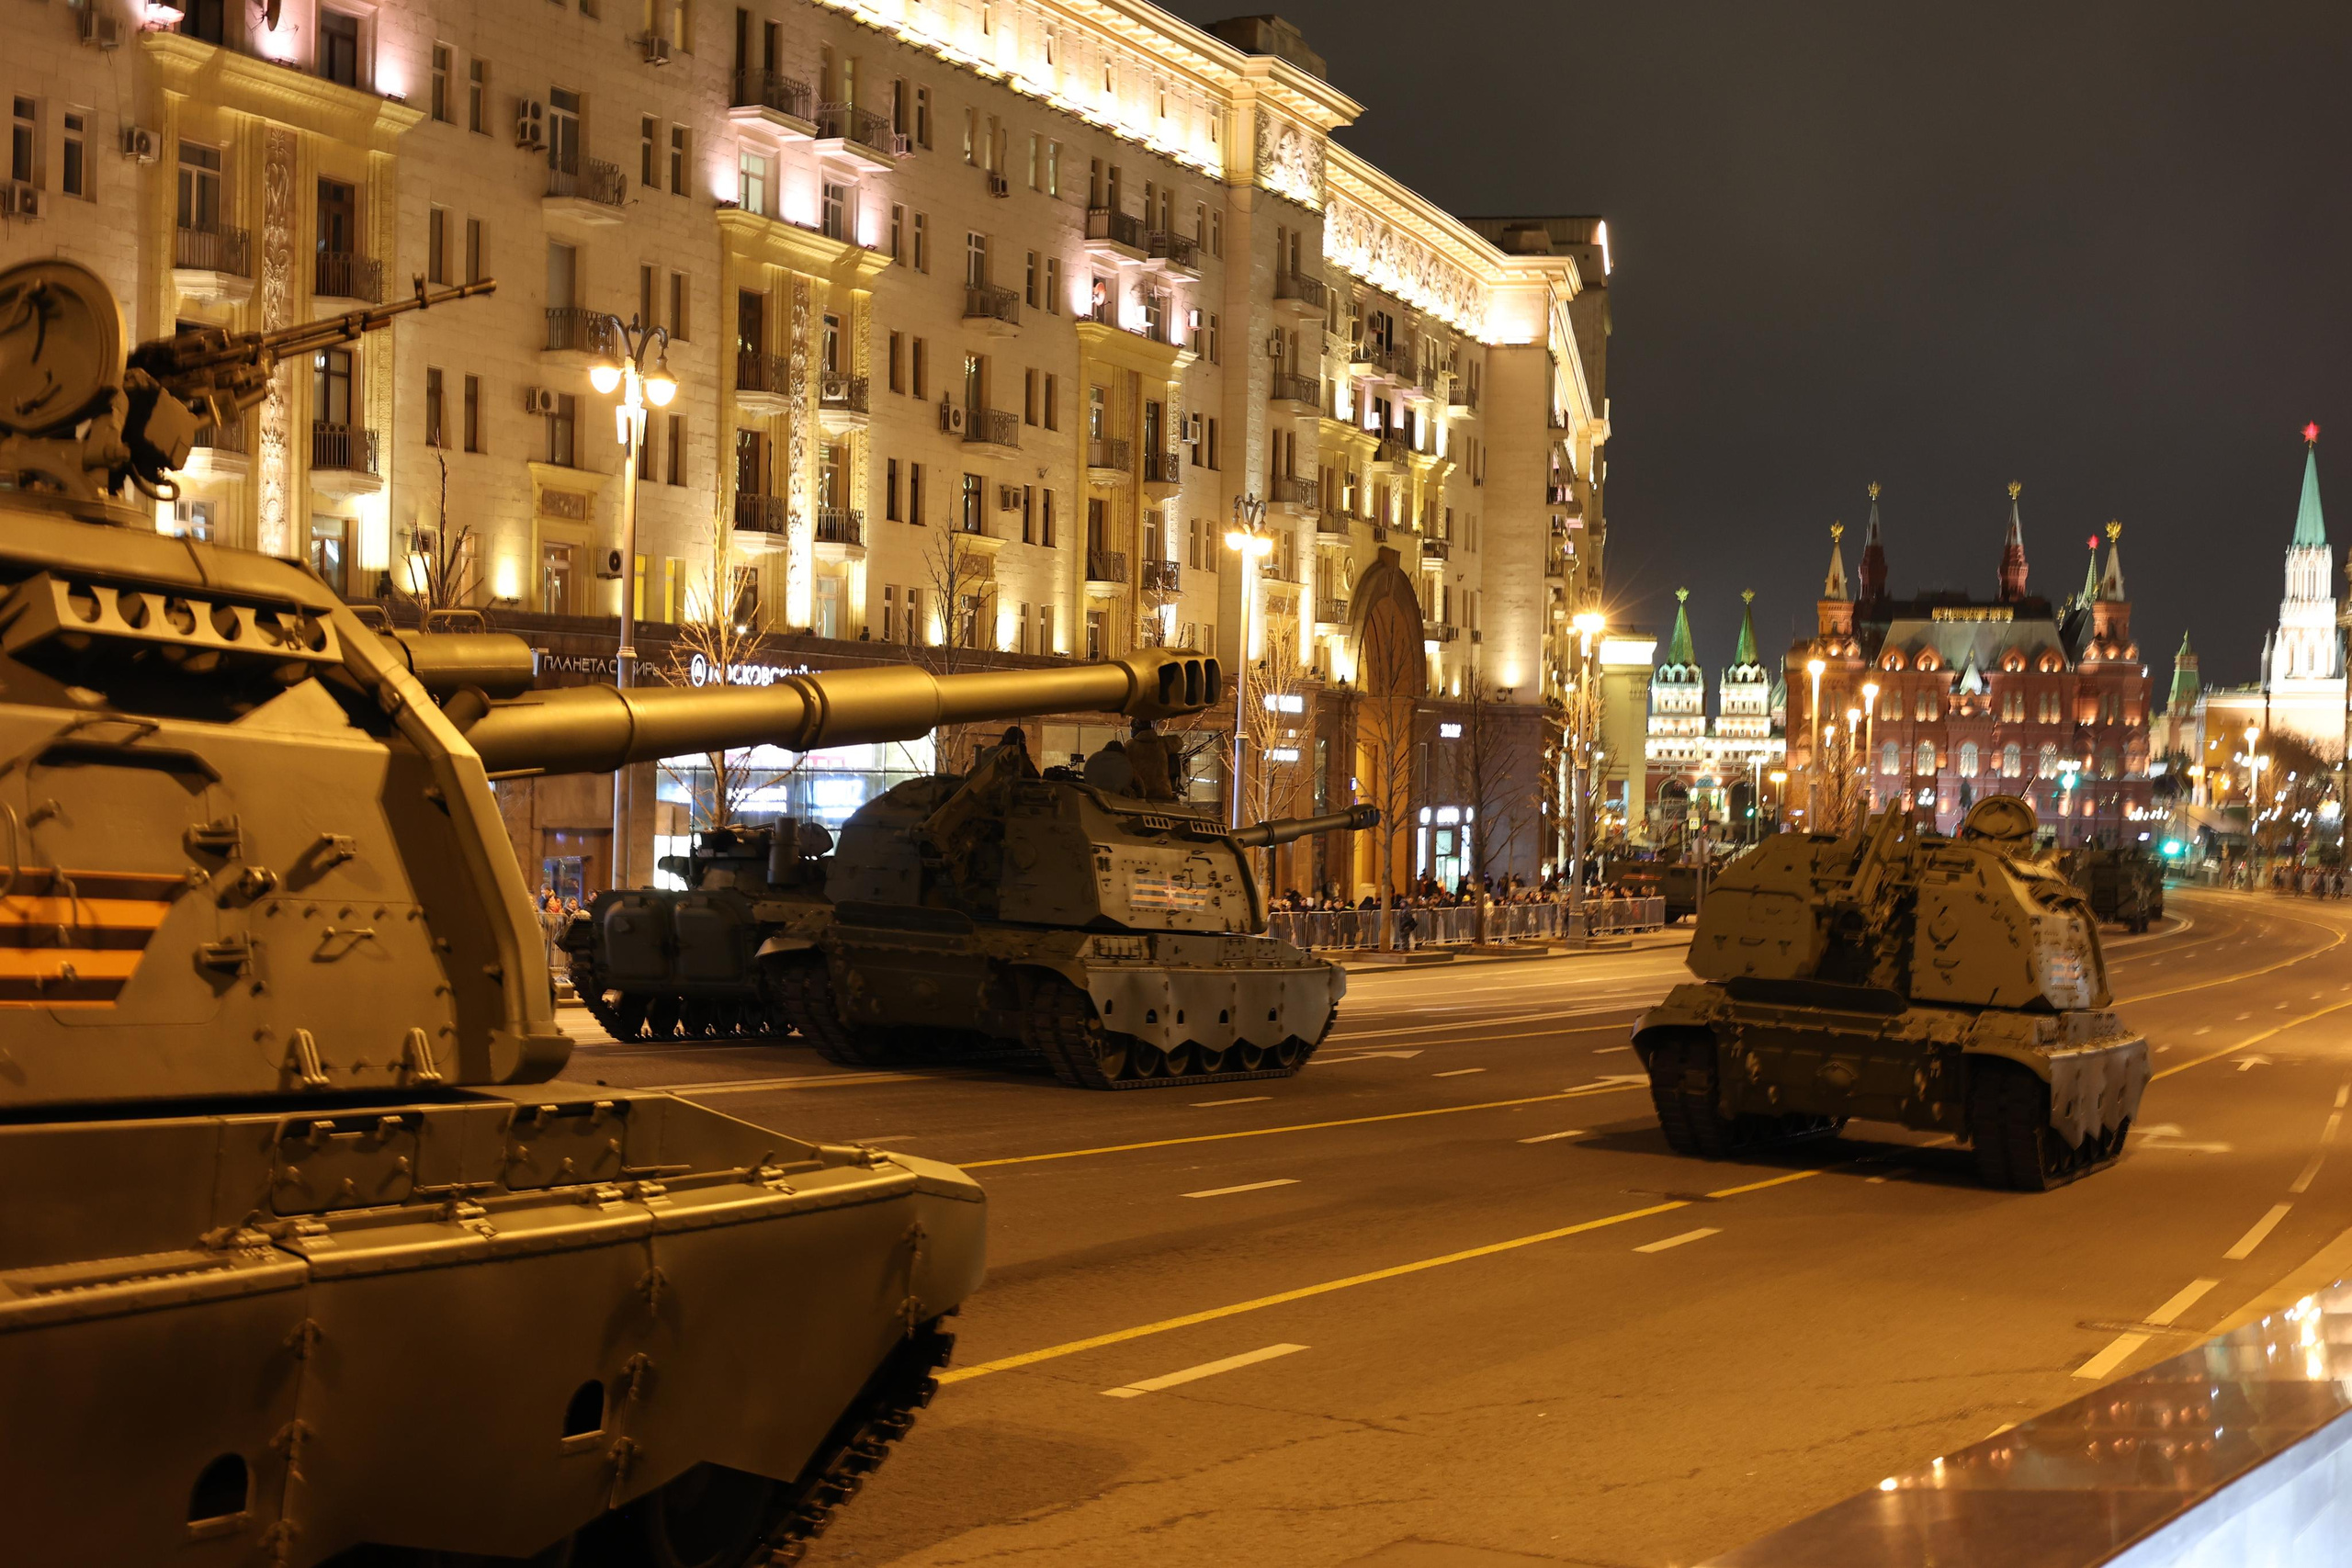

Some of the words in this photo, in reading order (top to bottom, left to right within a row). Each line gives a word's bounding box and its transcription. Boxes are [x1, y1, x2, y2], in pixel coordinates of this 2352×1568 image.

[543, 655, 607, 673] ПЛАНЕТА
[608, 660, 660, 677] СИРЬ
[708, 663, 808, 687] МСКОВС
